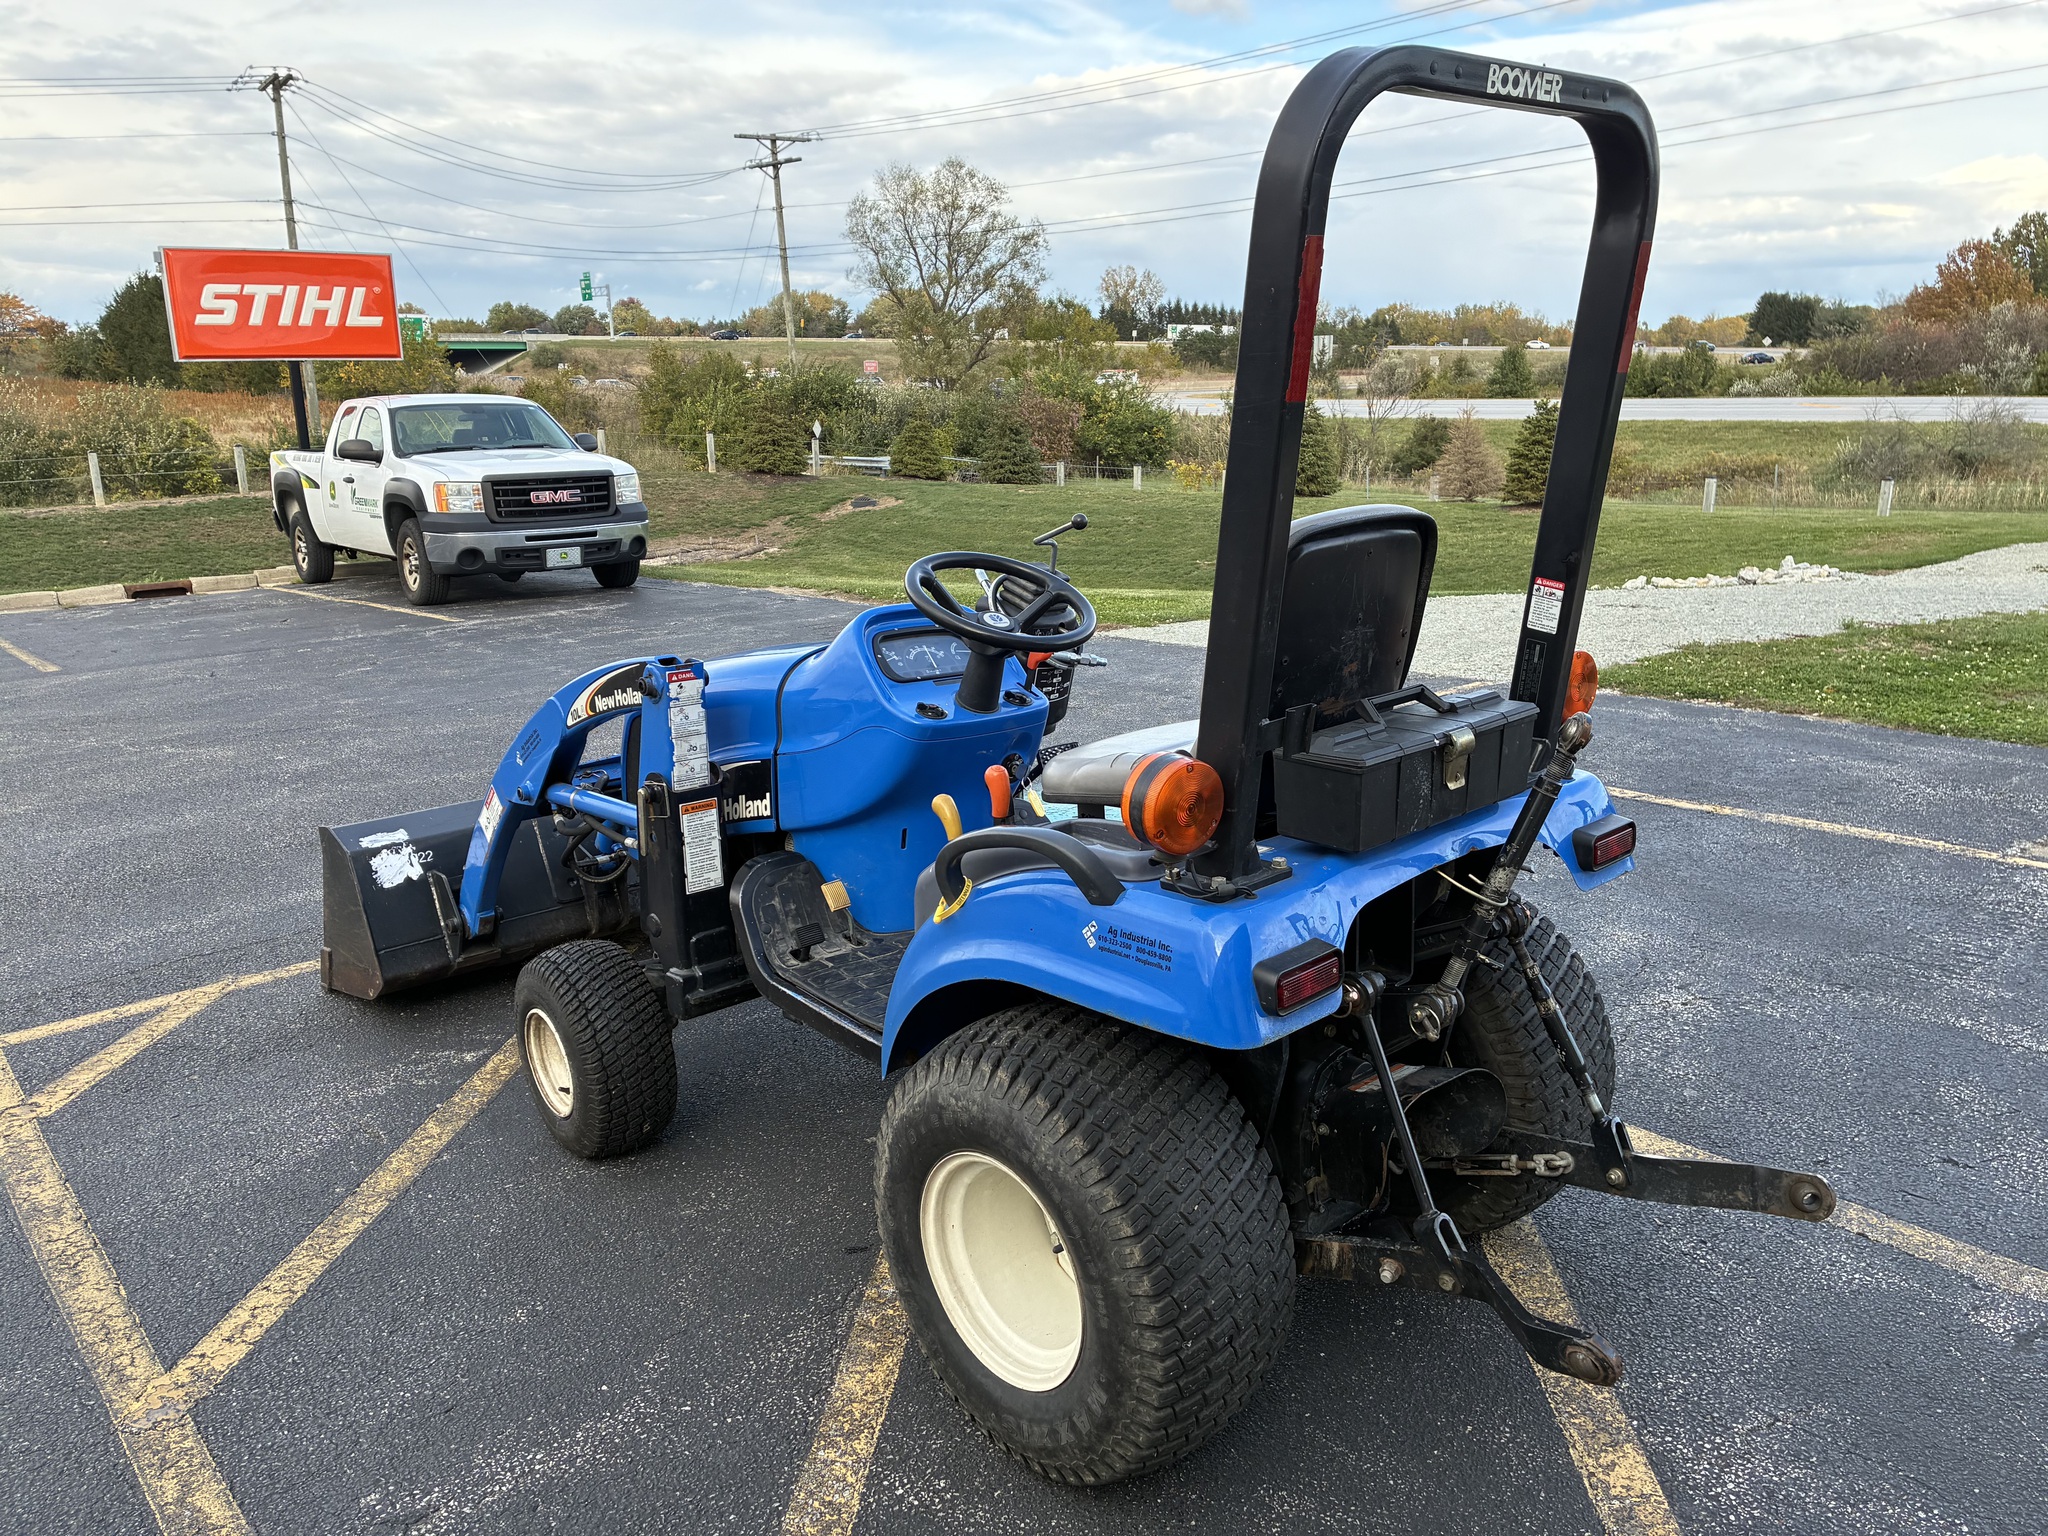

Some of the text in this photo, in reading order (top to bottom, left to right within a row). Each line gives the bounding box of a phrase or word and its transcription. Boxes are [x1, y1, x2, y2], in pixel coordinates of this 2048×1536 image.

[1486, 63, 1563, 104] BOOMER
[194, 283, 384, 327] STIHL
[530, 489, 581, 504] GMC
[1542, 580, 1564, 589] DANGER
[677, 672, 696, 680] DANG
[594, 694, 615, 713] New
[690, 802, 714, 811] WARNING
[723, 792, 771, 821] Holland
[1097, 934, 1172, 963] 610-323-2500 800-459-8800
[1107, 925, 1173, 953] Ag Industrial Inc.
